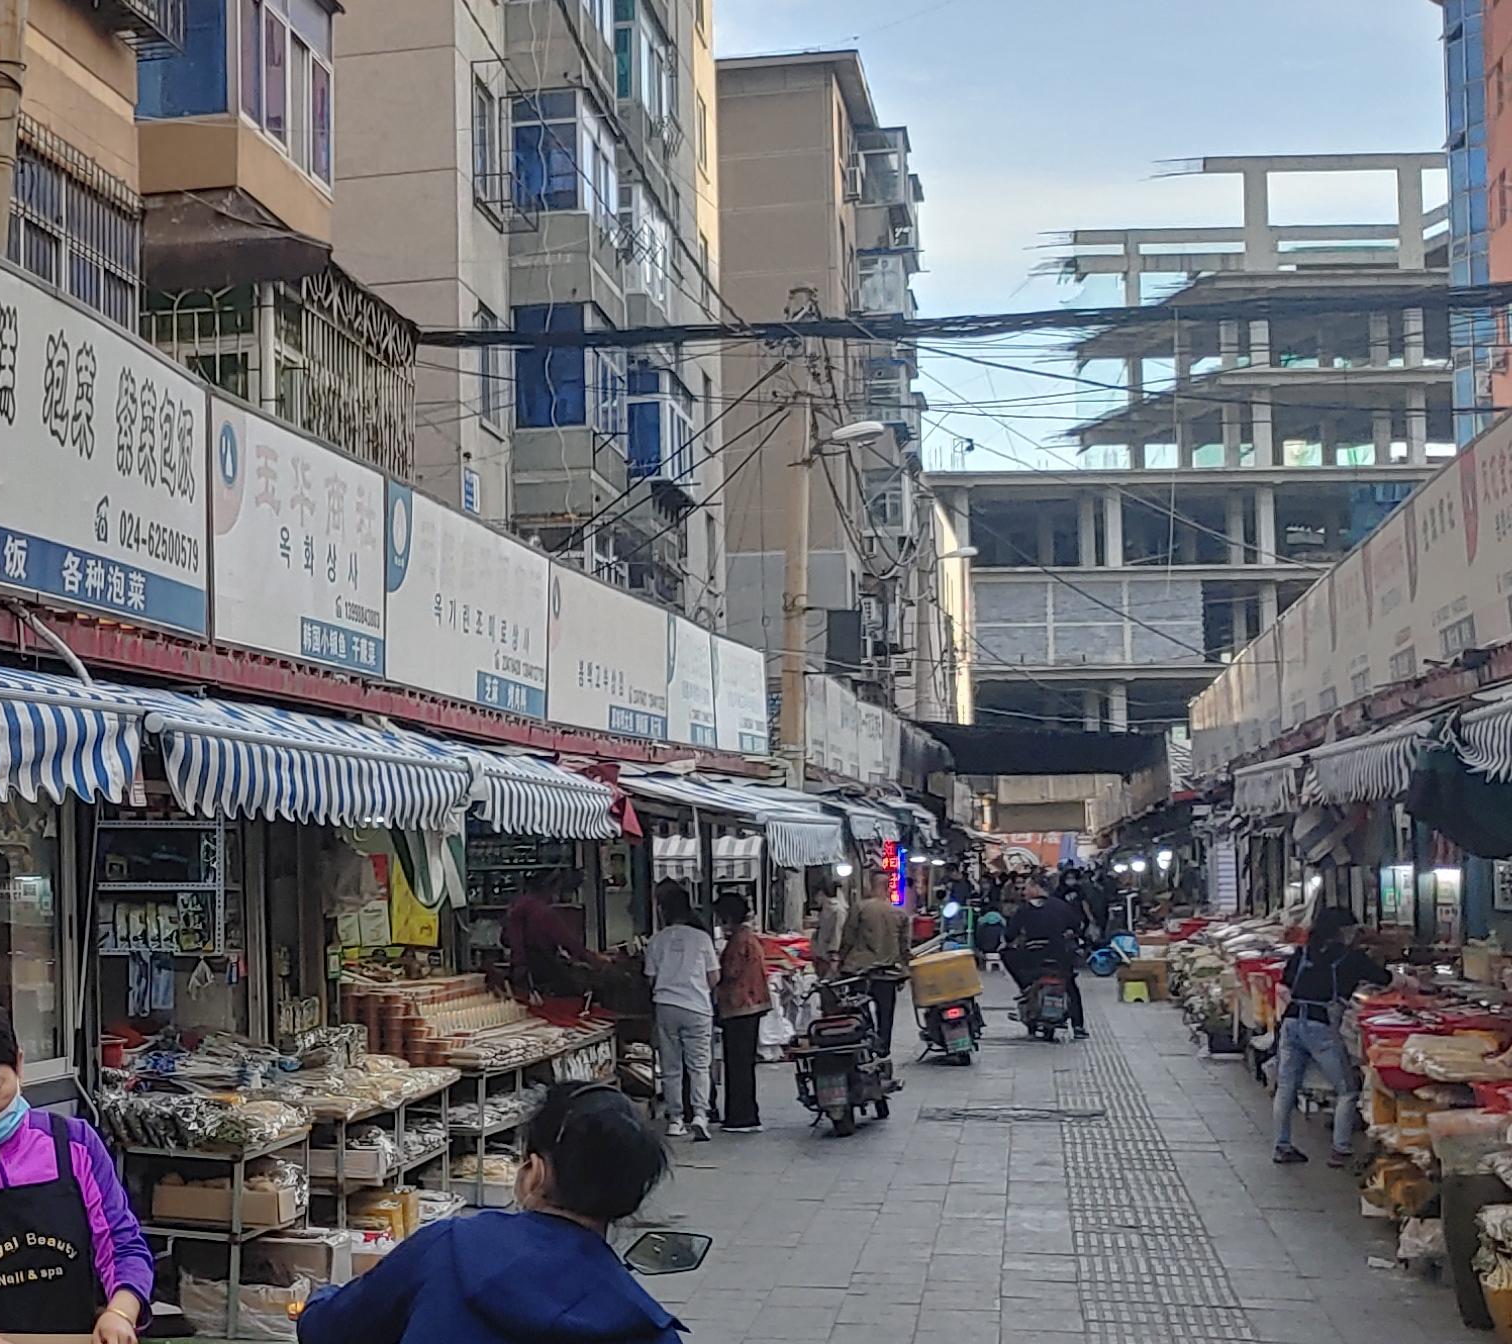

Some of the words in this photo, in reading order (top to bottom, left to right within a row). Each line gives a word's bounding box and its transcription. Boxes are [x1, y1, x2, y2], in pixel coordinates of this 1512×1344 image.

[43, 329, 96, 459] 泡菜
[116, 367, 194, 502] 紫菜包饭
[118, 510, 199, 573] 024-62500579
[280, 526, 358, 590] 옥화상사
[61, 551, 147, 611] 各种泡菜
[25, 1232, 78, 1259] Beauty
[28, 1269, 38, 1280] &
[40, 1266, 64, 1279] spa
